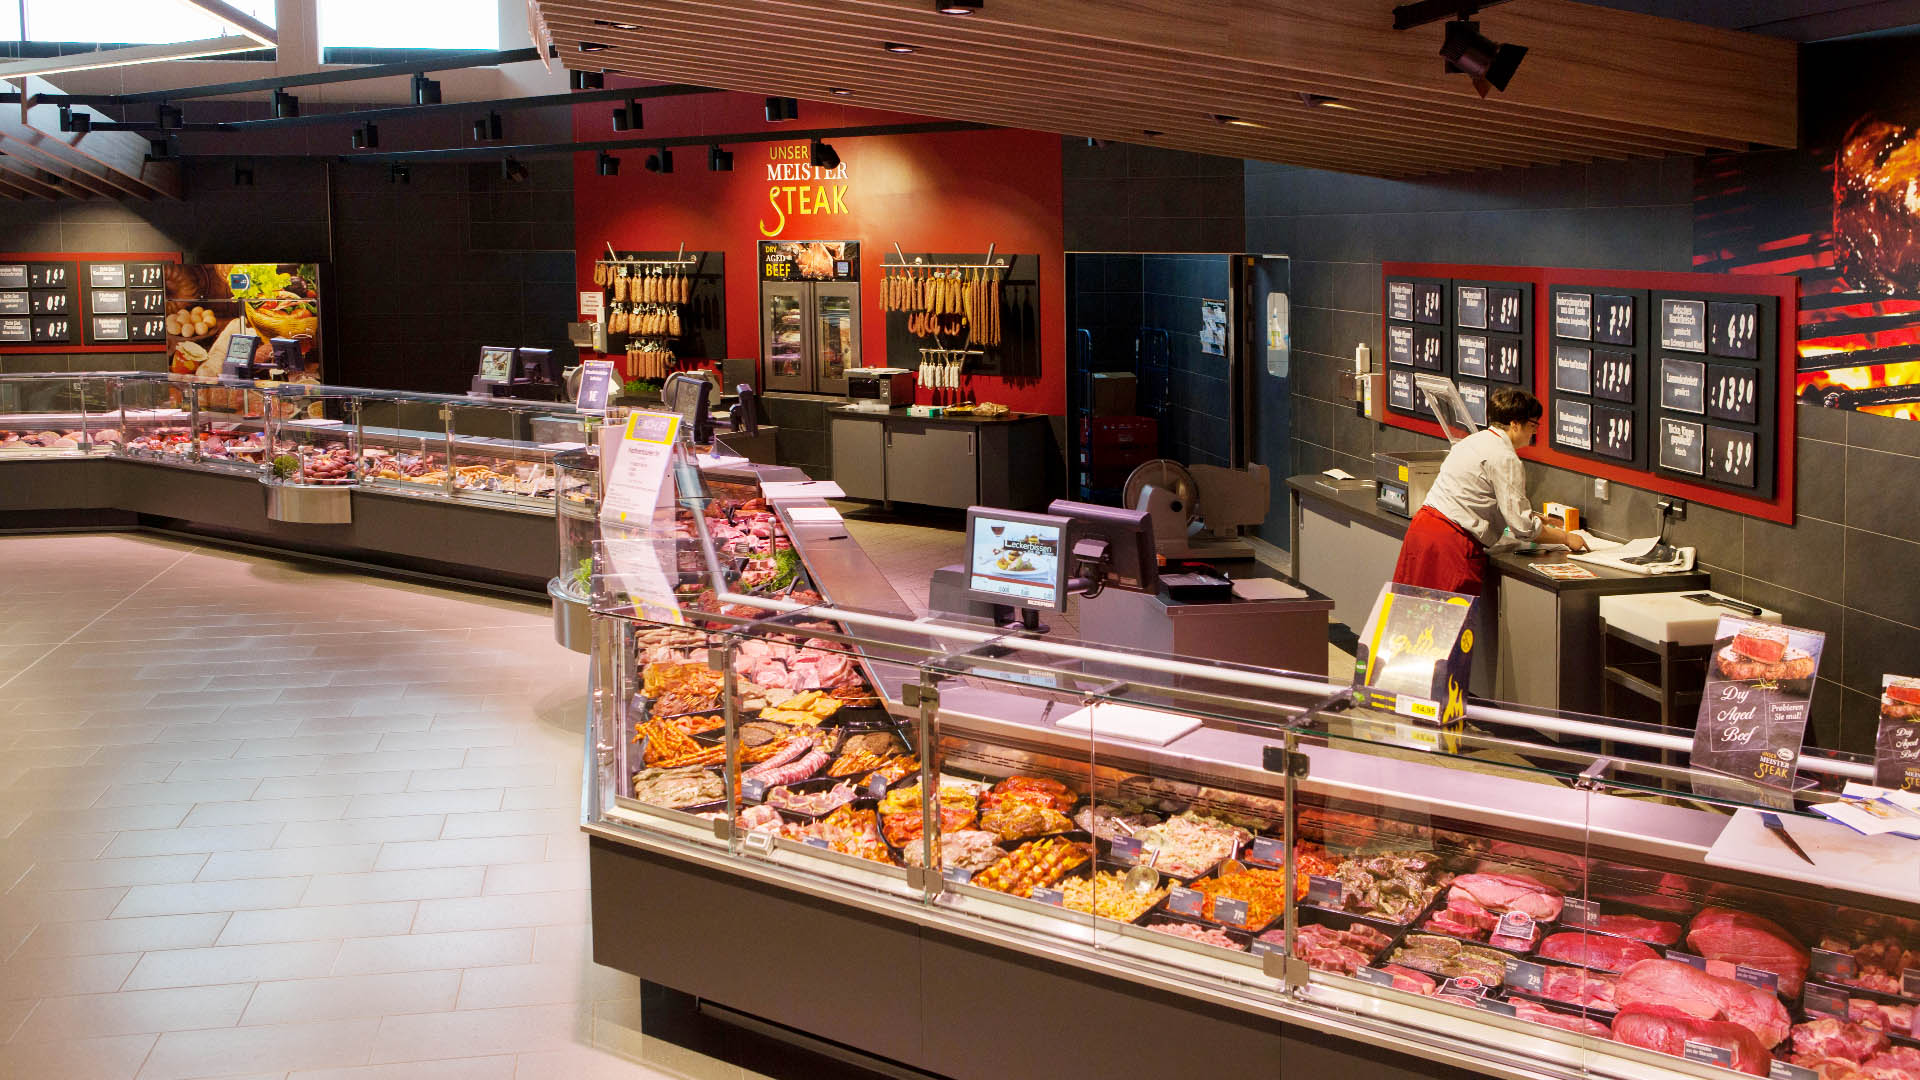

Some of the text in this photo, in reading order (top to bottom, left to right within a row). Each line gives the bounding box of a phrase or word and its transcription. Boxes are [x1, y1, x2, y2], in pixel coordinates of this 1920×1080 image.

[770, 145, 808, 160] UNSER
[766, 161, 849, 181] MEISTER
[760, 185, 849, 237] STEAK
[765, 245, 777, 253] DRY
[766, 254, 786, 262] AGED
[766, 263, 791, 277] BEEF
[1004, 539, 1052, 553] Leckerbissen
[1720, 686, 1750, 704] Dry
[1771, 704, 1804, 713] Probieren
[1717, 706, 1757, 726] Aged
[1774, 713, 1785, 721] Sie
[1720, 726, 1760, 745] Beef
[1896, 728, 1914, 738] Dry
[1896, 738, 1919, 750] Aged
[1760, 756, 1790, 769] MEISTER
[1754, 762, 1789, 779] STEAK
